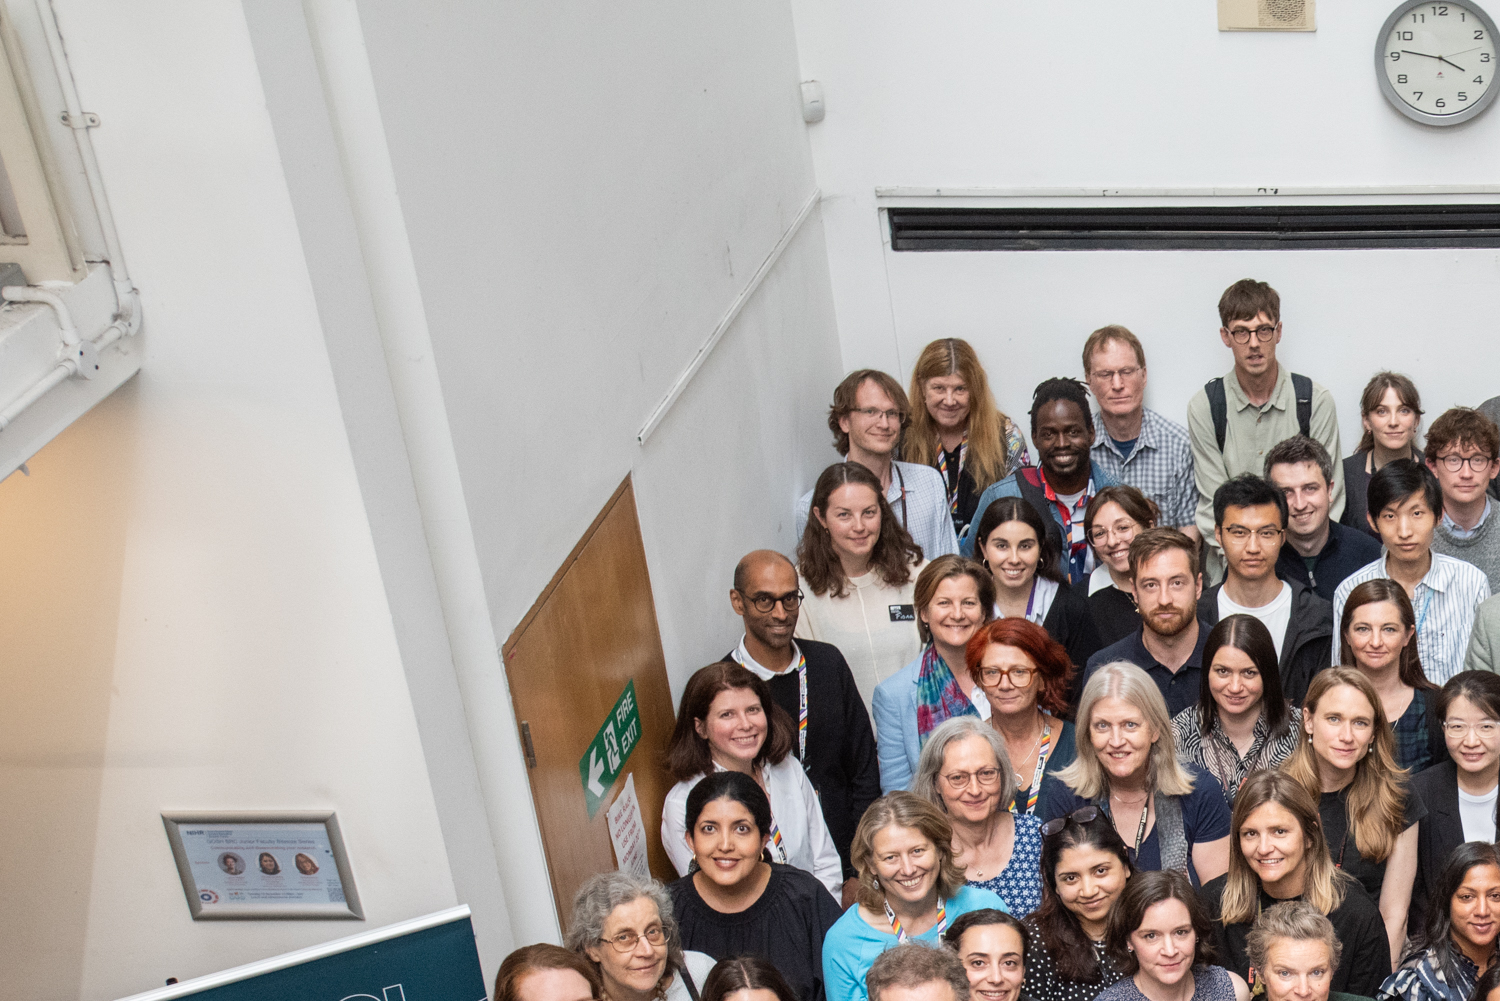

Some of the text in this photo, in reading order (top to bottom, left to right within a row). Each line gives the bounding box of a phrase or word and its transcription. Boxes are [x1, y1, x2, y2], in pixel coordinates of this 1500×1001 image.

[1432, 6, 1448, 16] 12
[1412, 13, 1425, 23] 11
[1460, 12, 1465, 22] 1
[1396, 31, 1413, 41] 10
[1473, 30, 1484, 40] 2
[1390, 51, 1401, 61] 9
[1480, 52, 1490, 63] 3
[1397, 74, 1408, 84] 8
[1472, 75, 1484, 85] 4
[1412, 91, 1424, 101] 7
[1457, 91, 1468, 101] 5
[1435, 98, 1446, 108] 6
[616, 691, 634, 729] FIRE
[621, 717, 637, 755] EXIT
[615, 828, 622, 840] NO
[621, 834, 629, 849] USE
